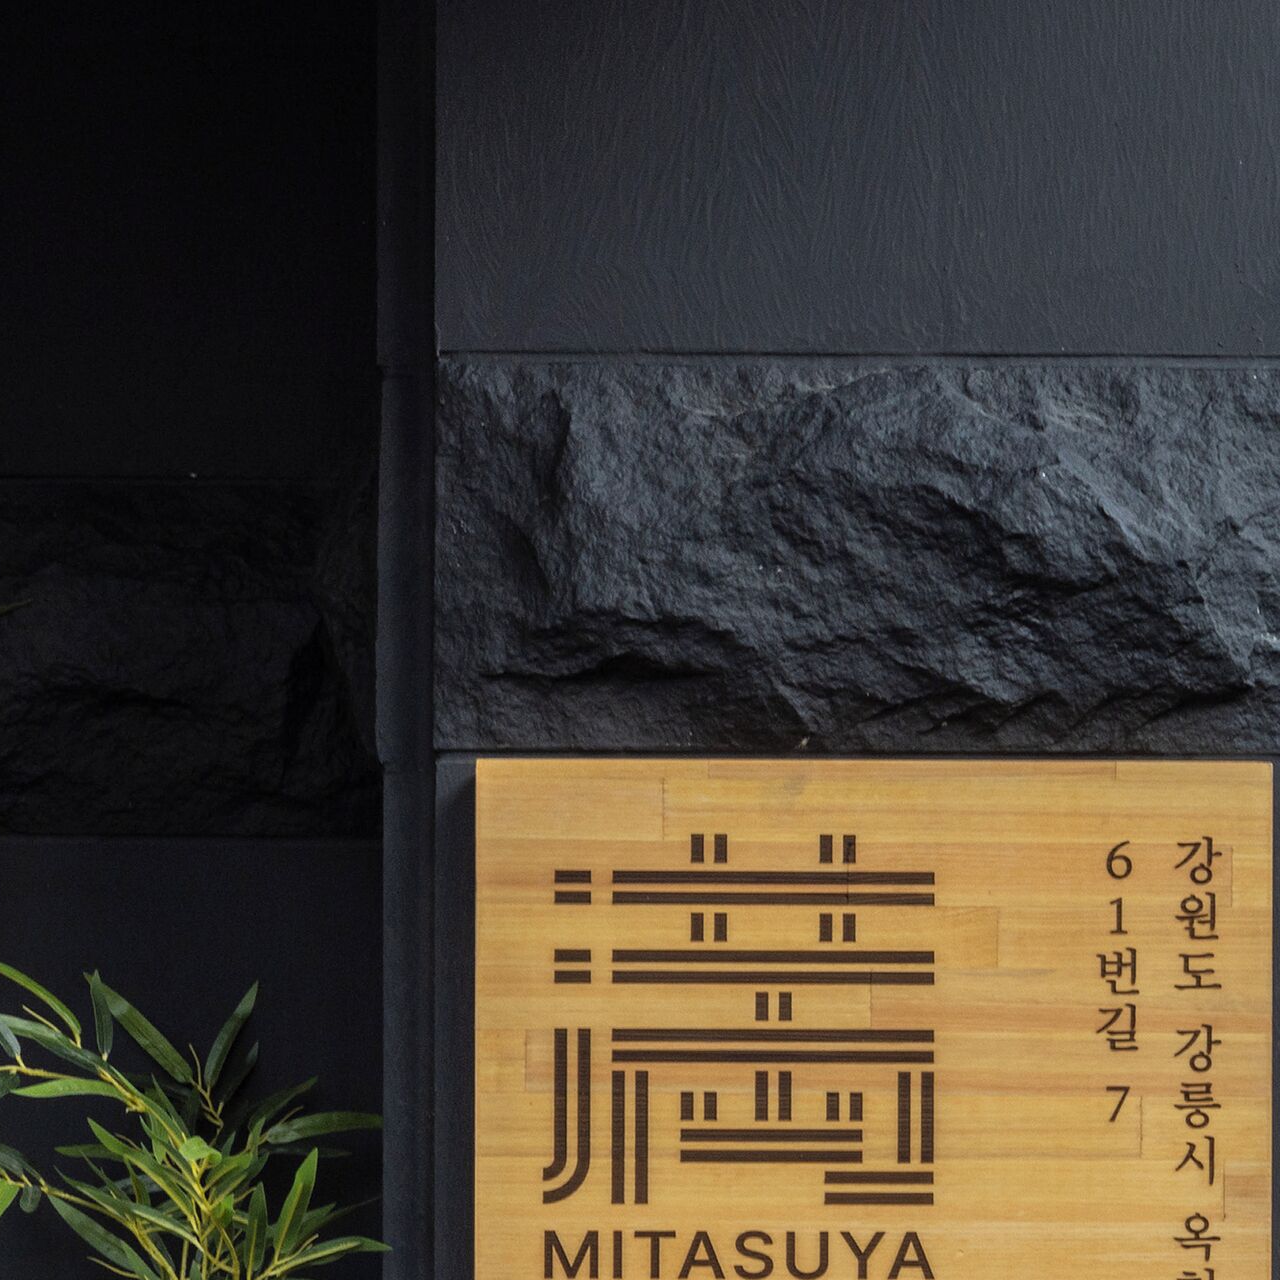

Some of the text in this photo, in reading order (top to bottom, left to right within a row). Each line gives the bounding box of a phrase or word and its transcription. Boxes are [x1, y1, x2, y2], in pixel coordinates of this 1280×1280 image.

[1096, 840, 1140, 1123] 61번길 7
[1174, 836, 1223, 990] 강원도
[1174, 1023, 1222, 1186] 강릉시
[543, 1230, 935, 1280] MITASUYA
